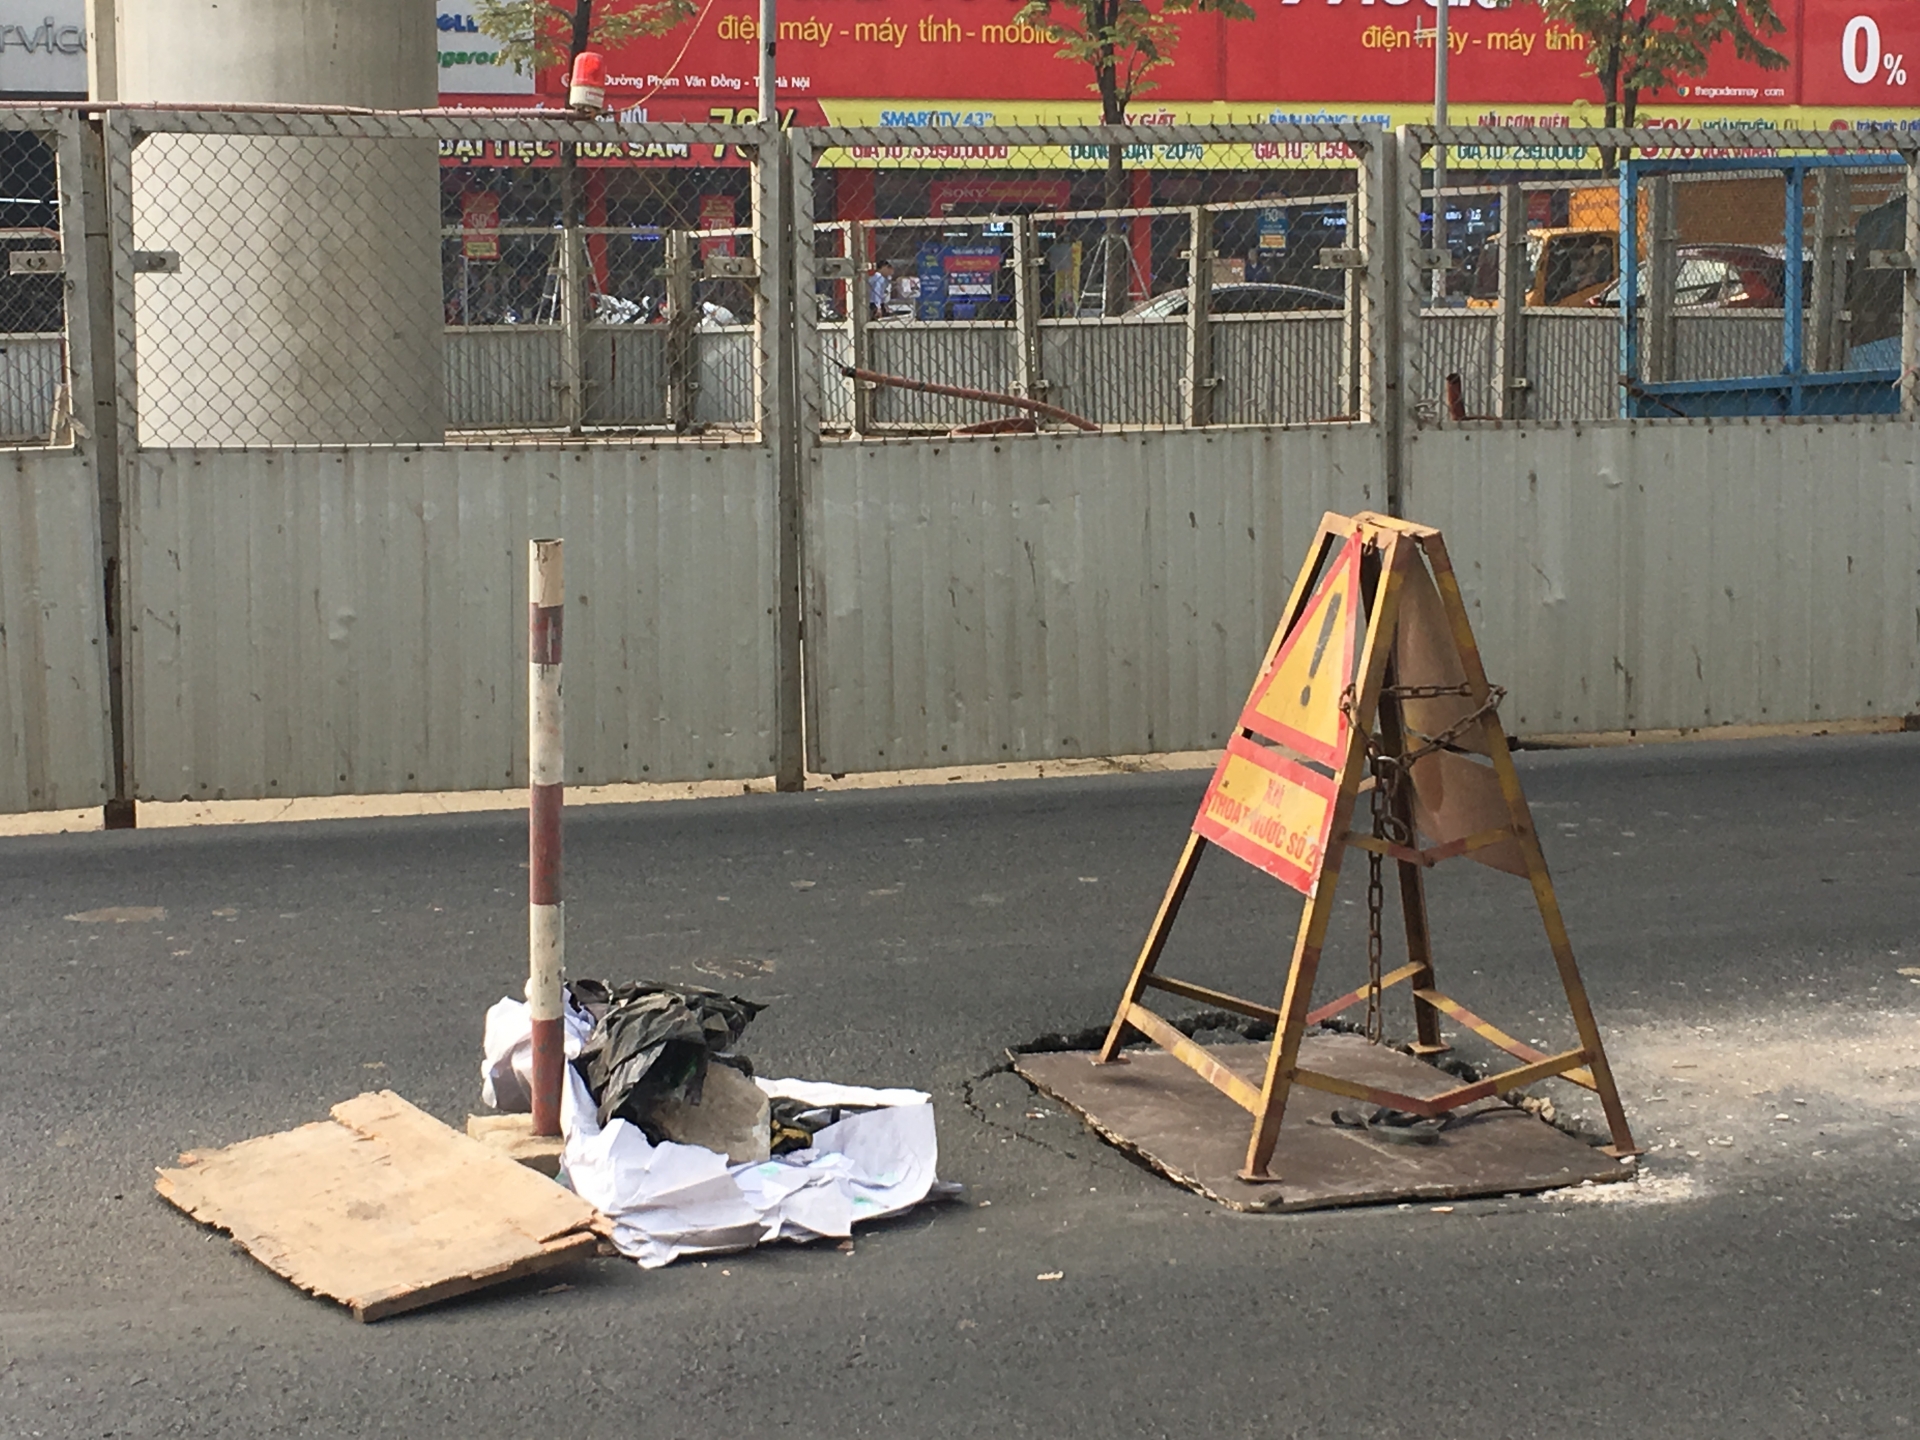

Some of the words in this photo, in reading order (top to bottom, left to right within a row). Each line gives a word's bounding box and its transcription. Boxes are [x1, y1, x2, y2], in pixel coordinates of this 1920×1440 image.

[779, 16, 833, 47] máy
[855, 17, 908, 48] máy
[918, 14, 961, 43] tính
[1361, 25, 1411, 52] điện
[1415, 26, 1468, 55] áy
[1487, 28, 1536, 55] máy
[1545, 24, 1583, 51] tính
